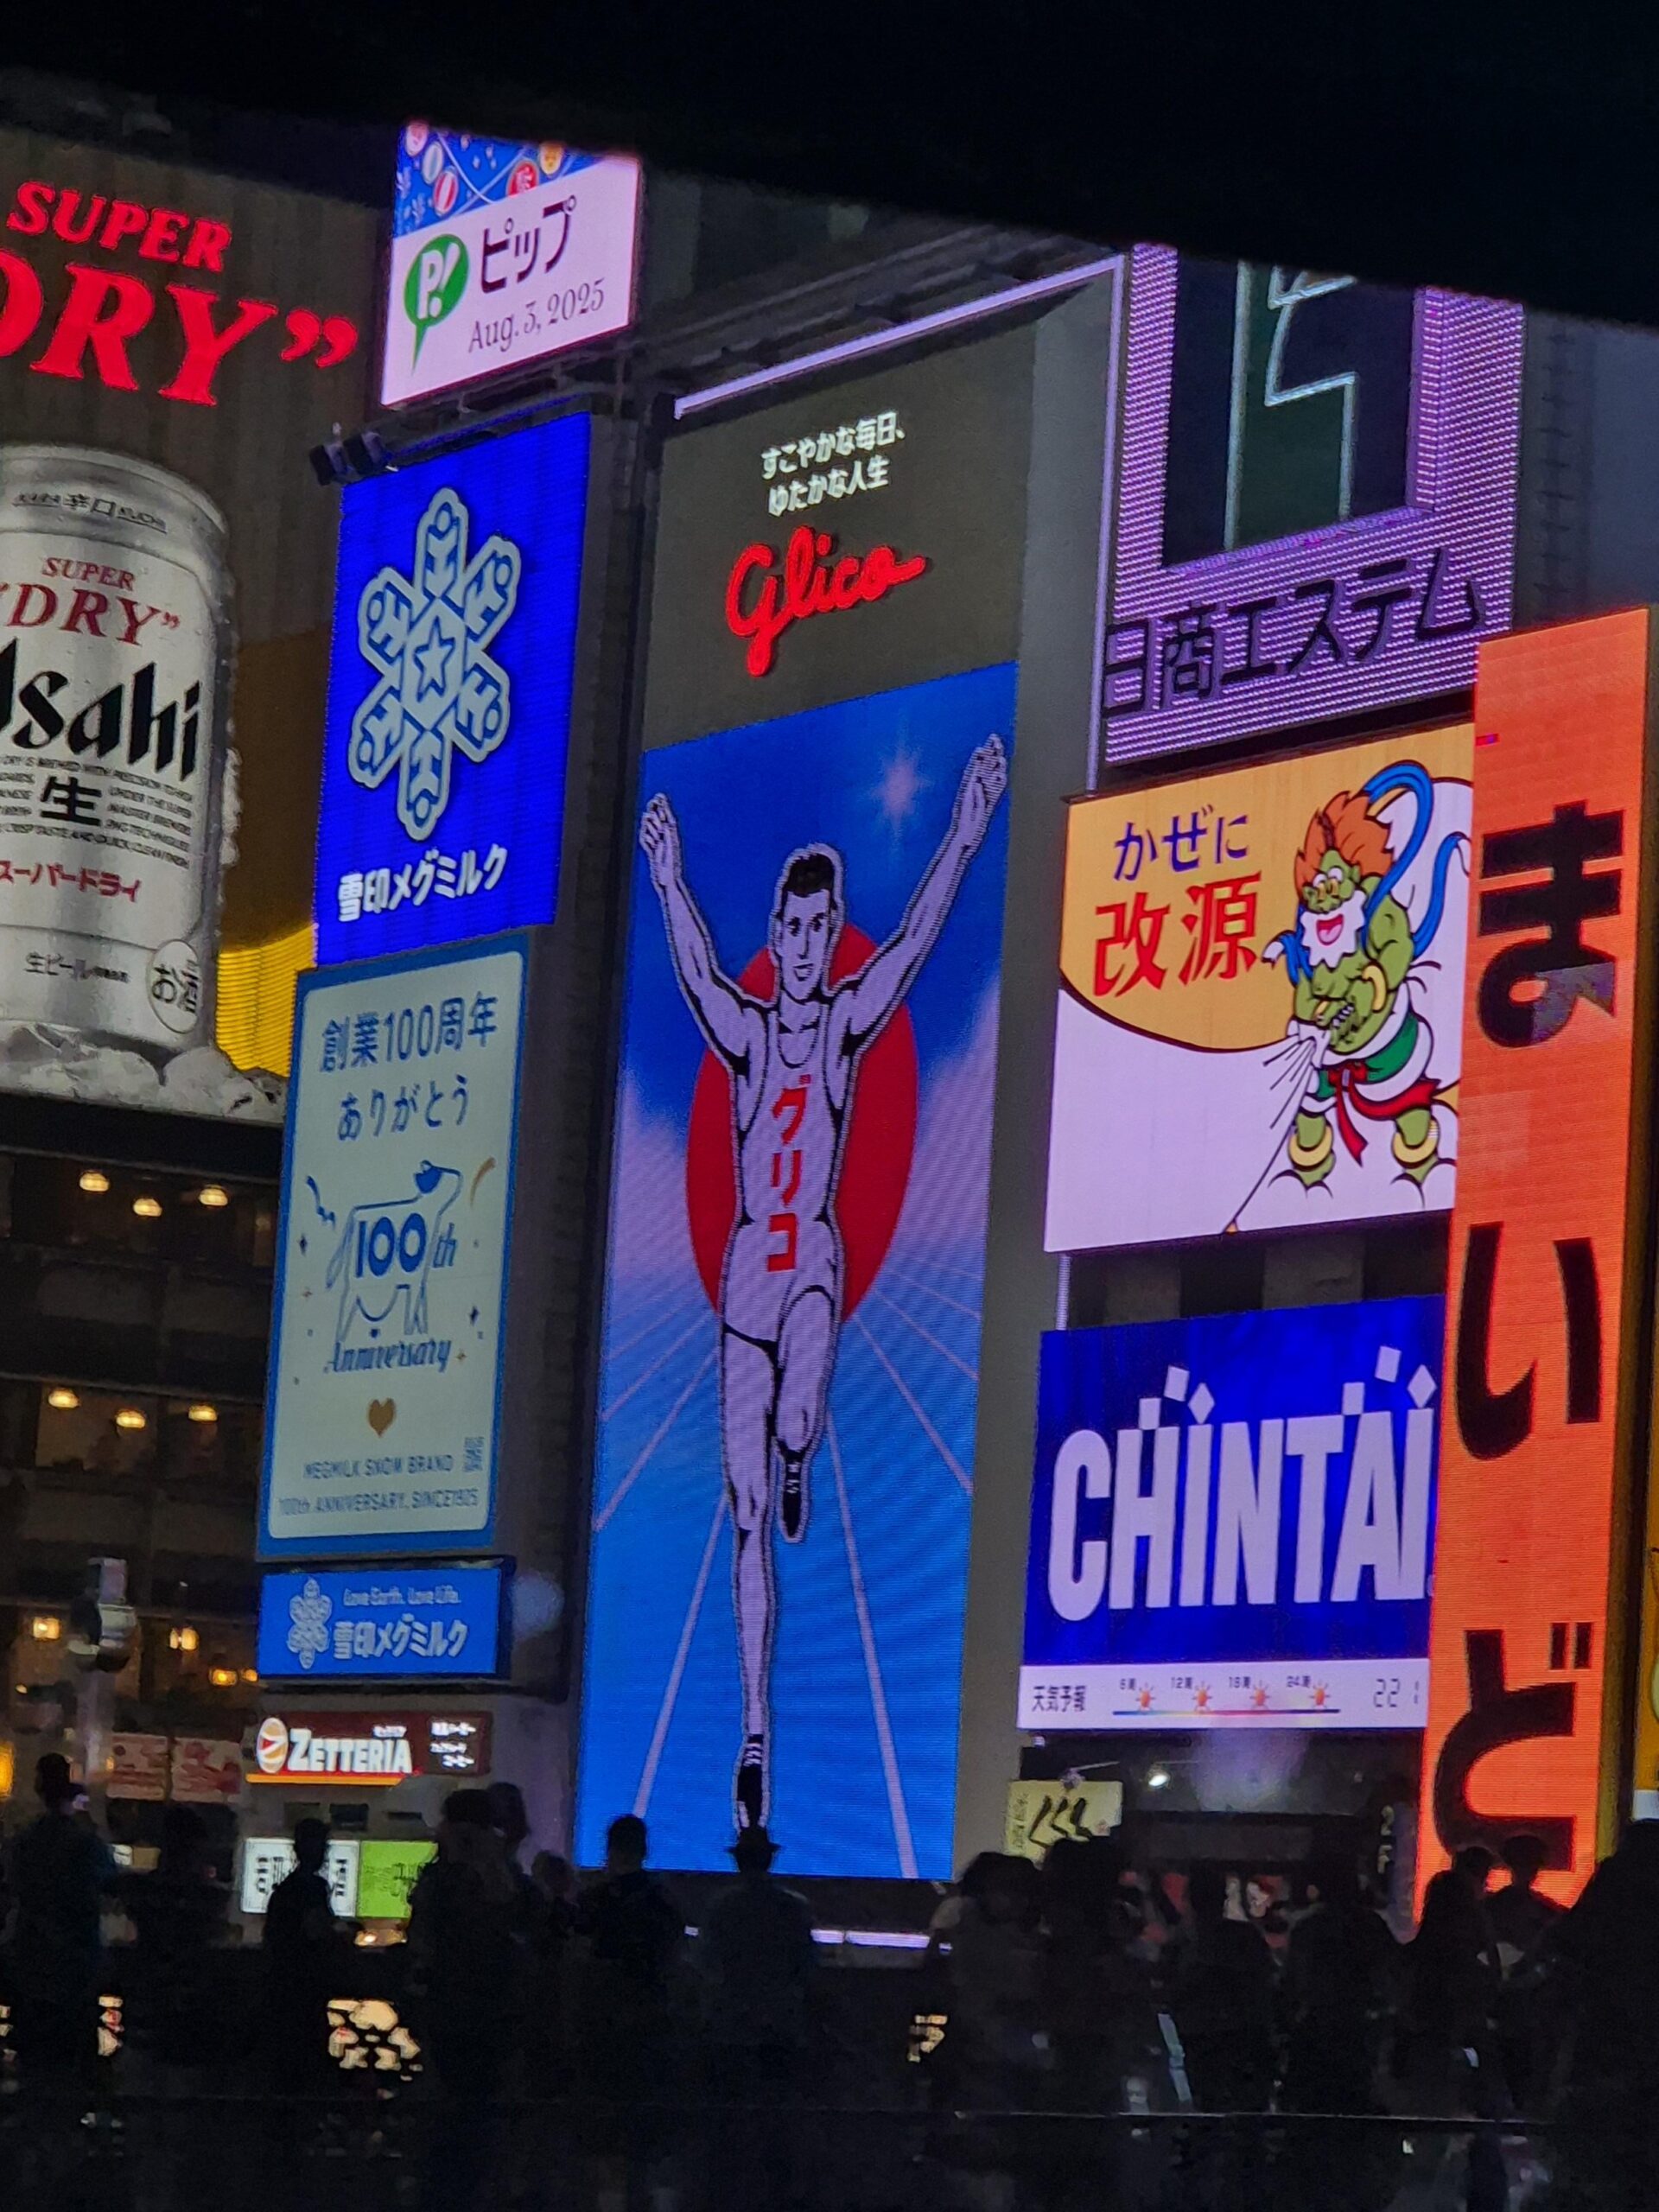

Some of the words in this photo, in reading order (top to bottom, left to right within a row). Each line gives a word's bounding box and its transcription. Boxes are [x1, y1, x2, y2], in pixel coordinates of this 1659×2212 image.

[7, 181, 232, 273] SUPER
[481, 194, 576, 294] ピップ
[768, 454, 889, 518] ゆたかな人生
[42, 556, 135, 591] SUPER
[1102, 547, 1486, 719] 日商エステム
[0, 637, 200, 781] sahi
[40, 775, 102, 827] 生
[338, 842, 508, 922] 雪印メグミルク
[1113, 804, 1249, 881] かぜに
[1093, 871, 1262, 998] 改源
[320, 991, 498, 1073] 創業100周年
[338, 1074, 468, 1141] ありがとう
[767, 1074, 811, 1273] グリコ
[1433, 800, 1624, 1871] まいど
[1047, 1345, 1437, 1622] CHINTAI
[333, 1612, 468, 1659] 雪印メグミルク
[287, 1728, 413, 1774] ZETTERIA
